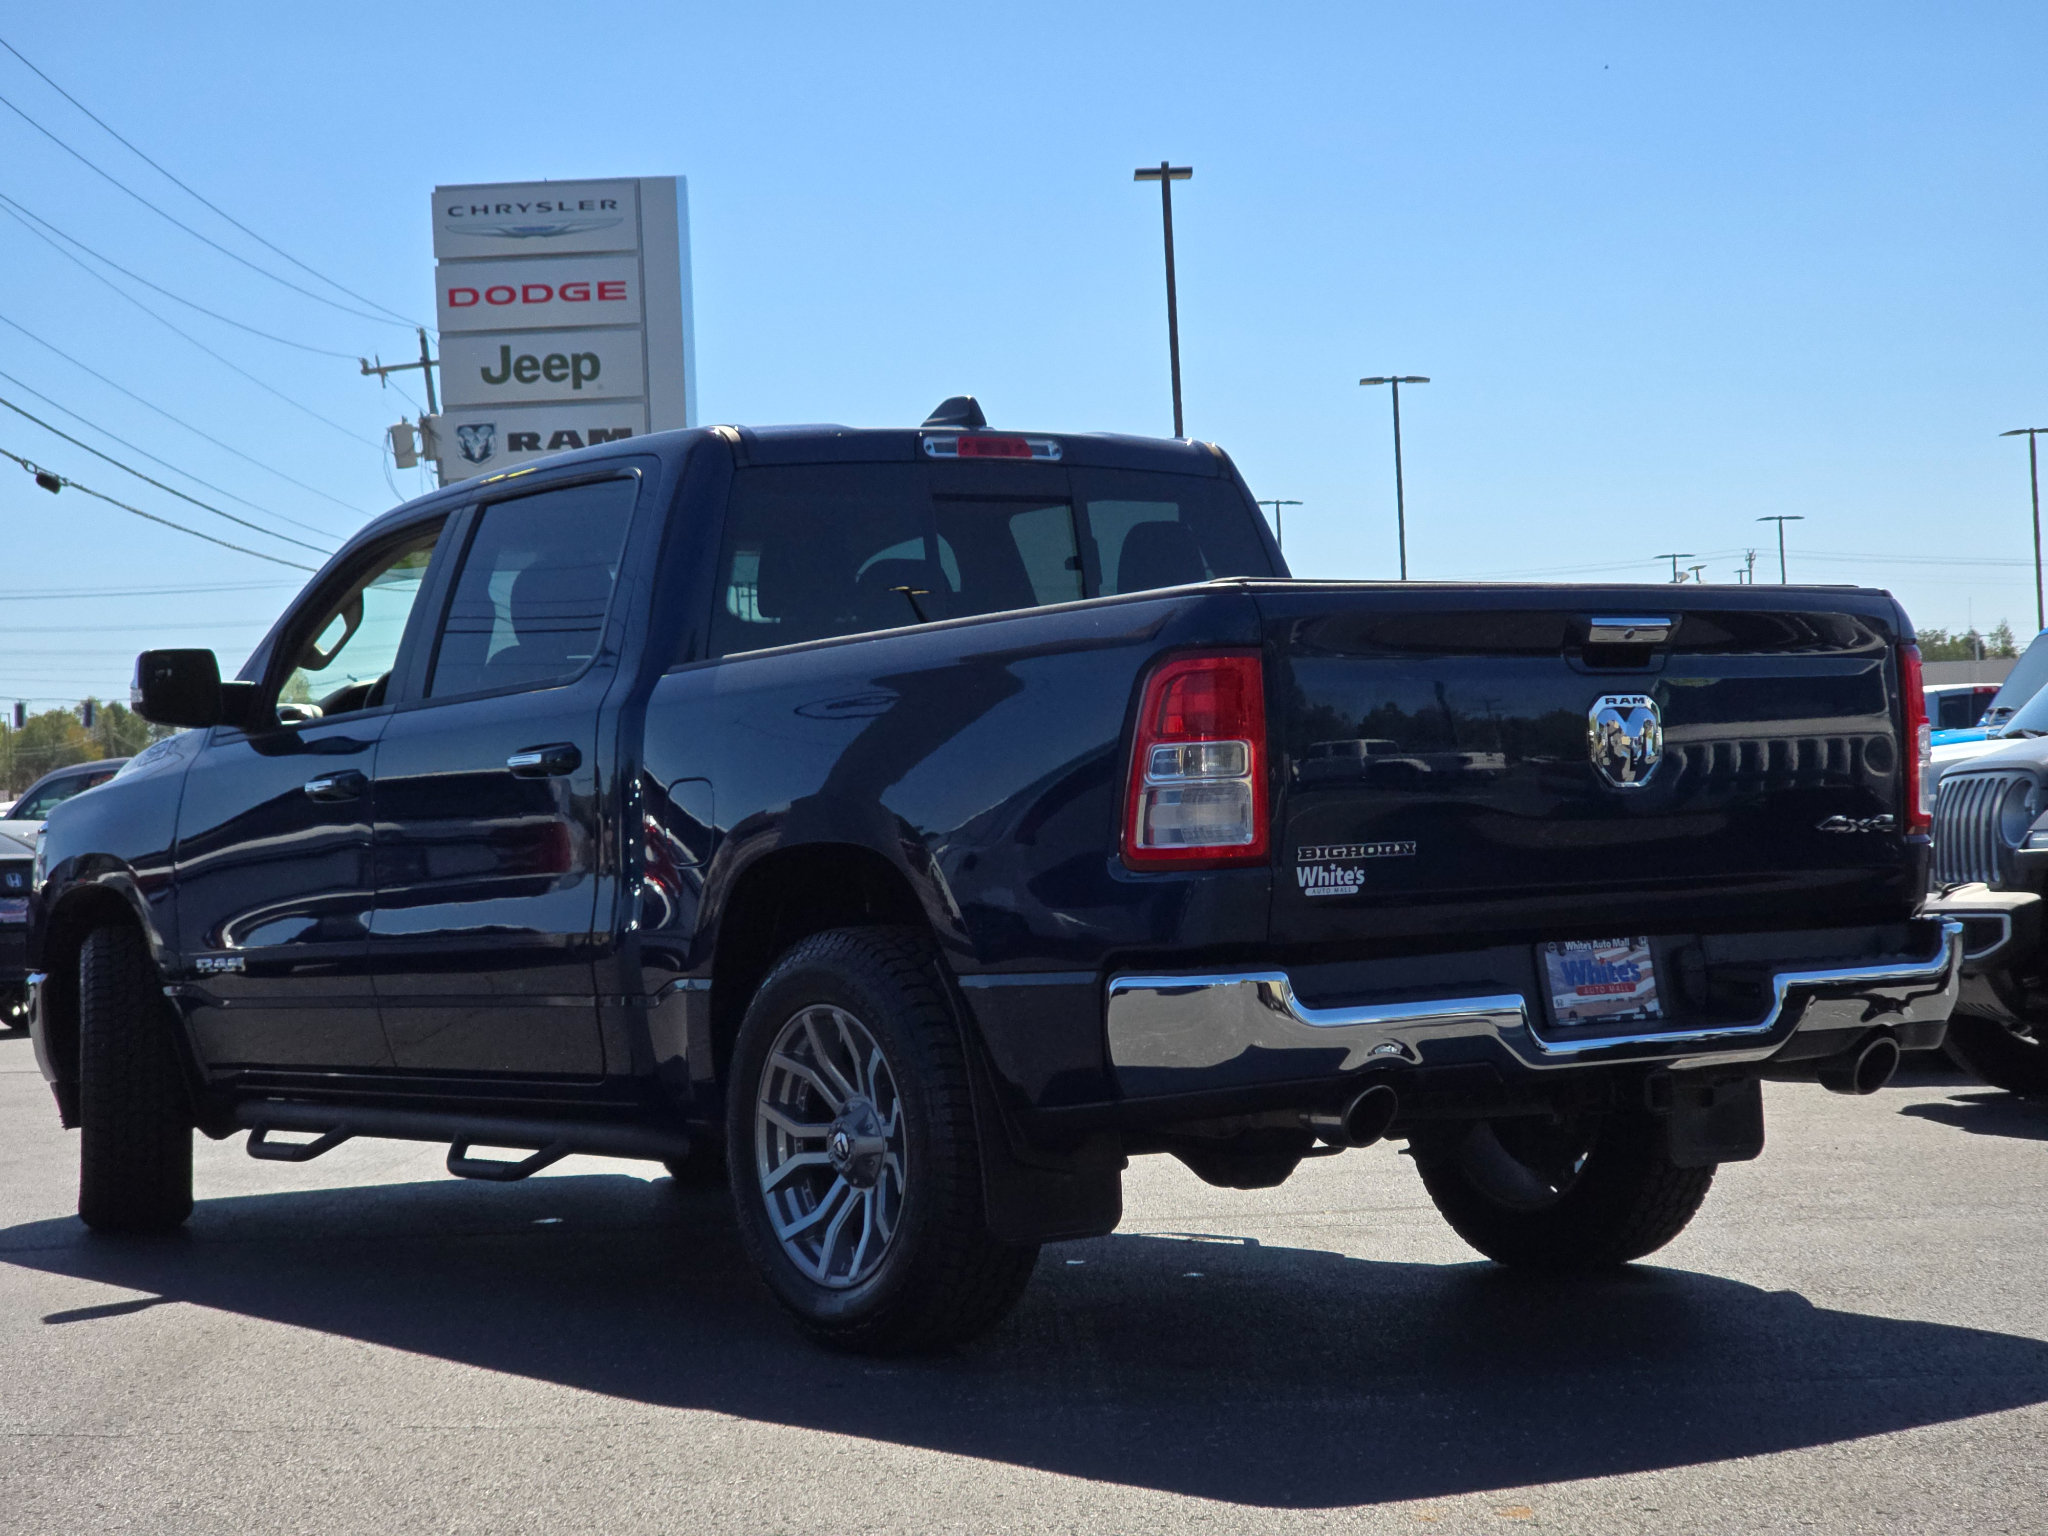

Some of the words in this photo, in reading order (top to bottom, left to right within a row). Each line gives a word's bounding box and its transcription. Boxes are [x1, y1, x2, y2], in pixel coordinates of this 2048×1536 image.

[447, 199, 617, 217] CHRYSLER
[448, 280, 627, 308] DODGE
[480, 345, 601, 390] Jeep
[507, 427, 632, 452] RAM
[1604, 697, 1645, 705] RAM
[1296, 863, 1365, 887] White's
[1593, 939, 1611, 949] Auto
[1612, 937, 1630, 947] Mall
[196, 957, 246, 973] RAM
[1560, 959, 1641, 986] White's
[1584, 986, 1606, 995] AUTO
[1609, 984, 1630, 992] MALL
